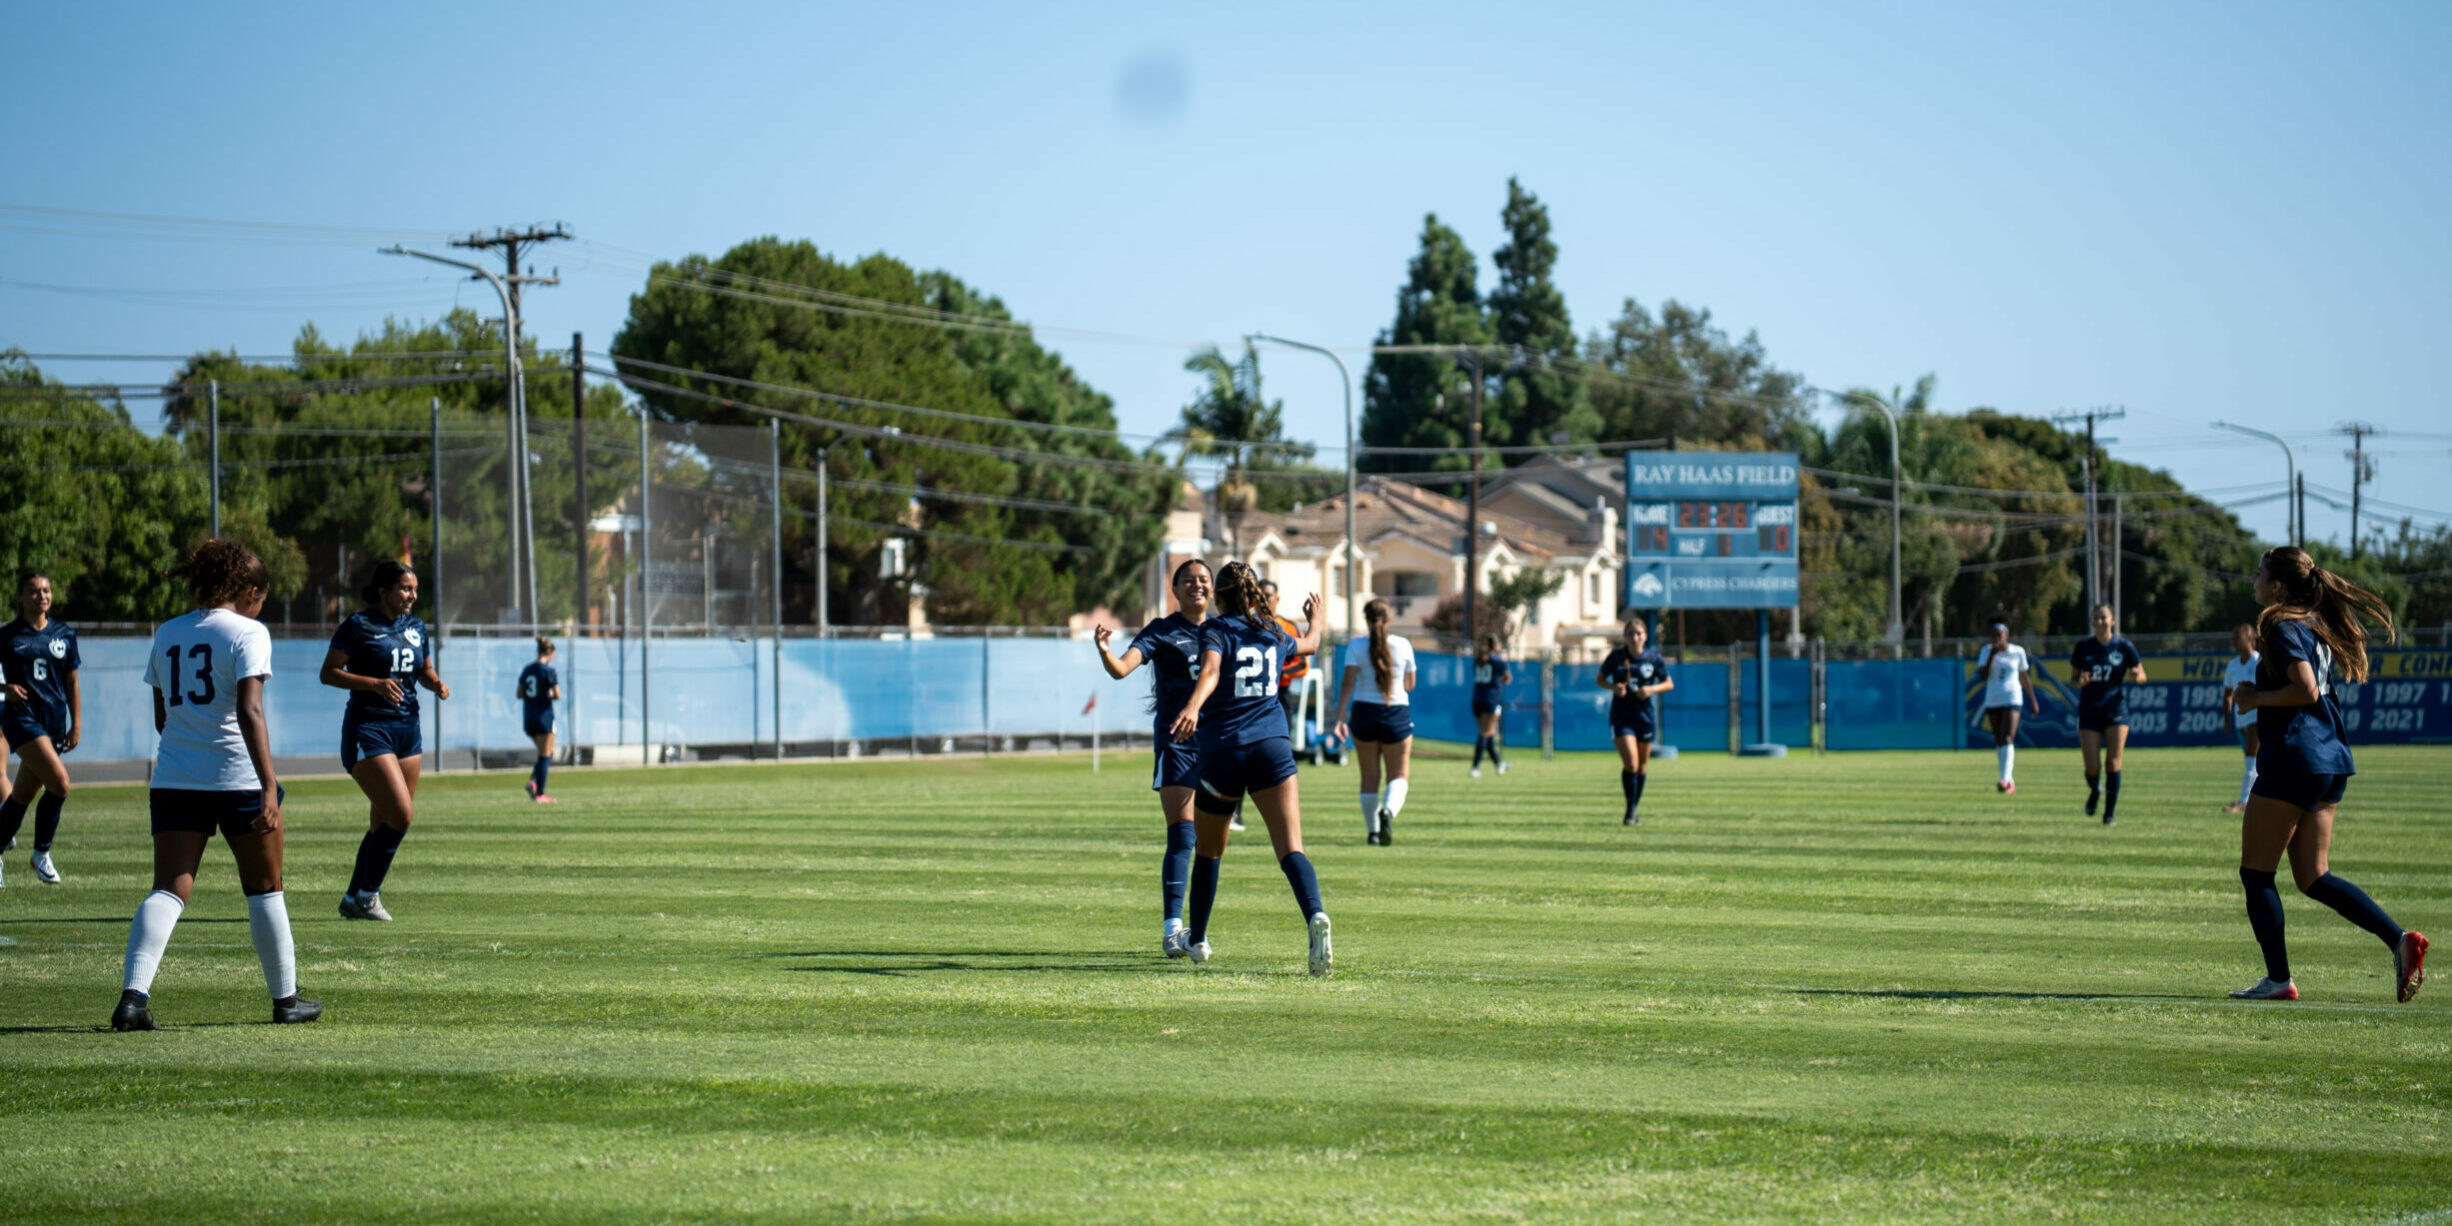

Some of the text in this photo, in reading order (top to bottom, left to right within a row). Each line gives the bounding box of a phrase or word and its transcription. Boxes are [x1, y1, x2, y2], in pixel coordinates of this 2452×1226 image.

[1634, 465, 1796, 486] RAY HAAS FIELD
[33, 658, 47, 681] 6
[390, 647, 415, 673] 12
[1234, 646, 1278, 697] 21
[166, 643, 216, 707] 13
[2092, 664, 2112, 681] 27
[526, 675, 538, 698] 3
[2374, 682, 2427, 705] 1997
[2129, 712, 2169, 734] 003
[2370, 708, 2425, 731] 2021
